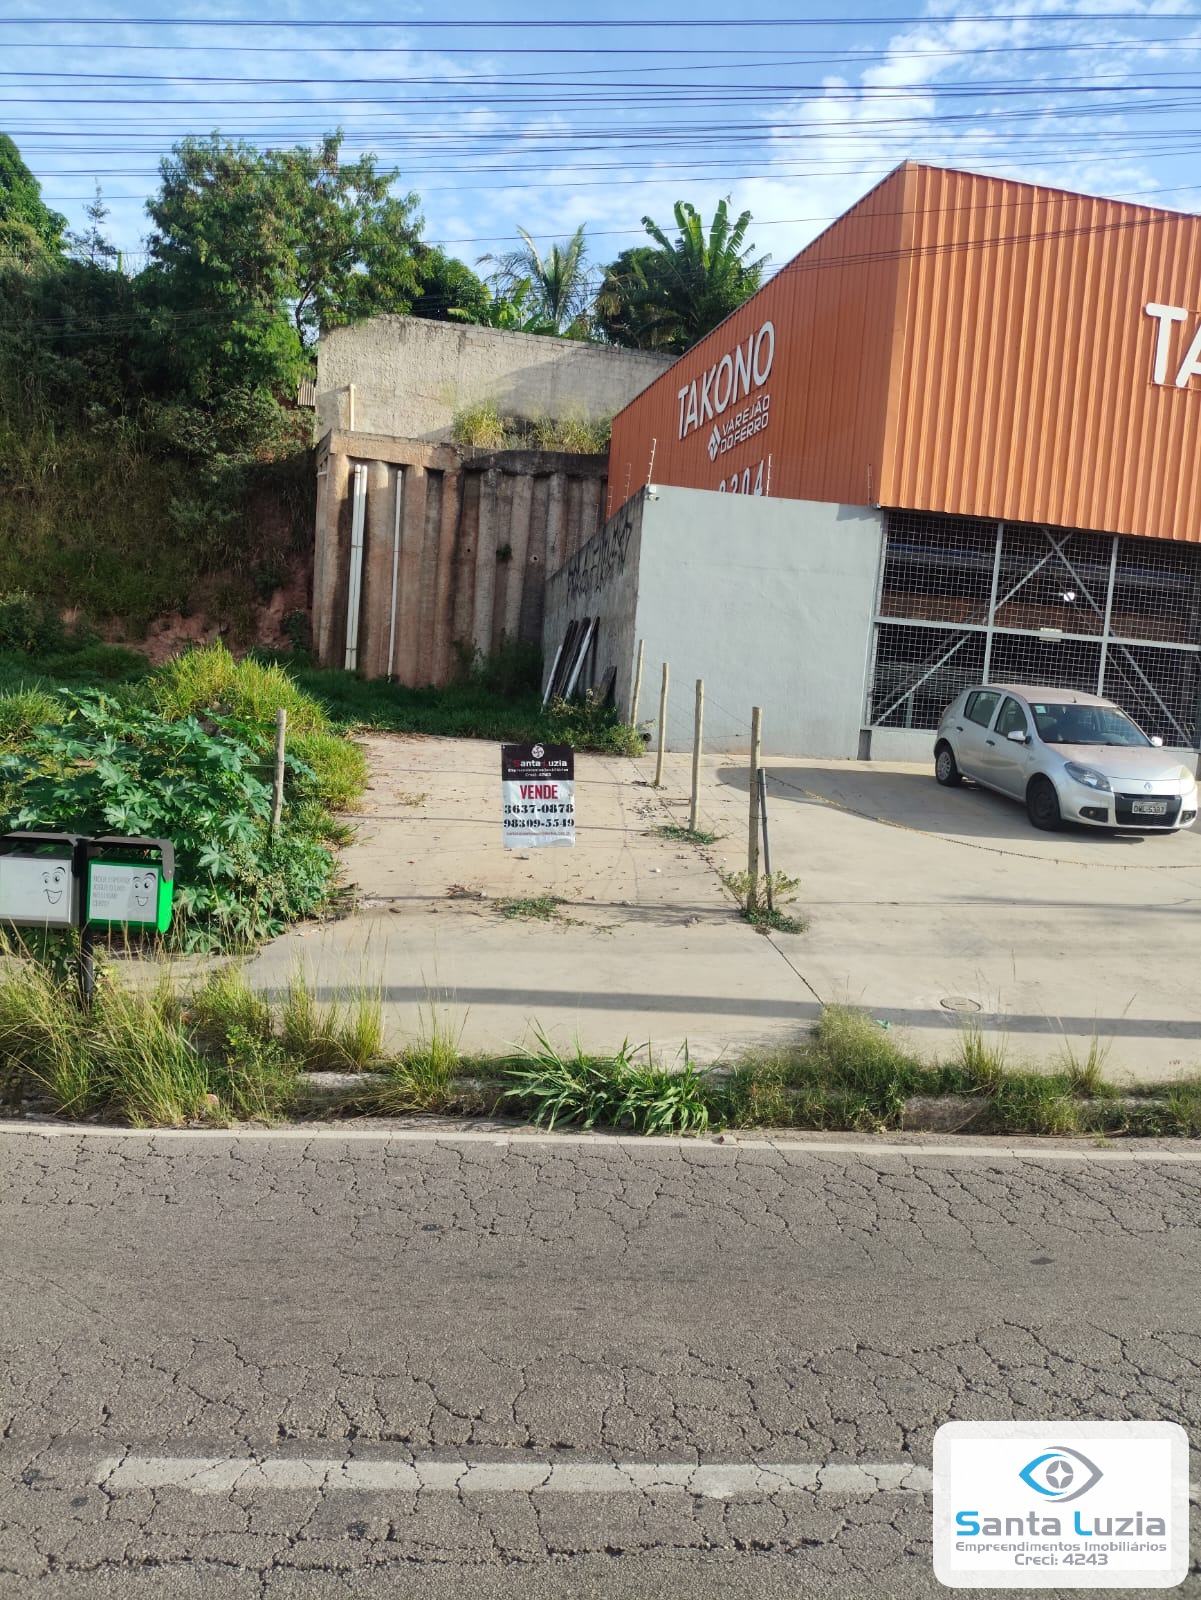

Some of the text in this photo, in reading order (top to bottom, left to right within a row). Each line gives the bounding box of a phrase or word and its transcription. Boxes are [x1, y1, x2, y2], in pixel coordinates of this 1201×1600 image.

[678, 321, 775, 440] TAKONO
[722, 394, 770, 436] VAREJÃO
[520, 785, 558, 799] VENDE
[504, 804, 574, 814] 3637-0878
